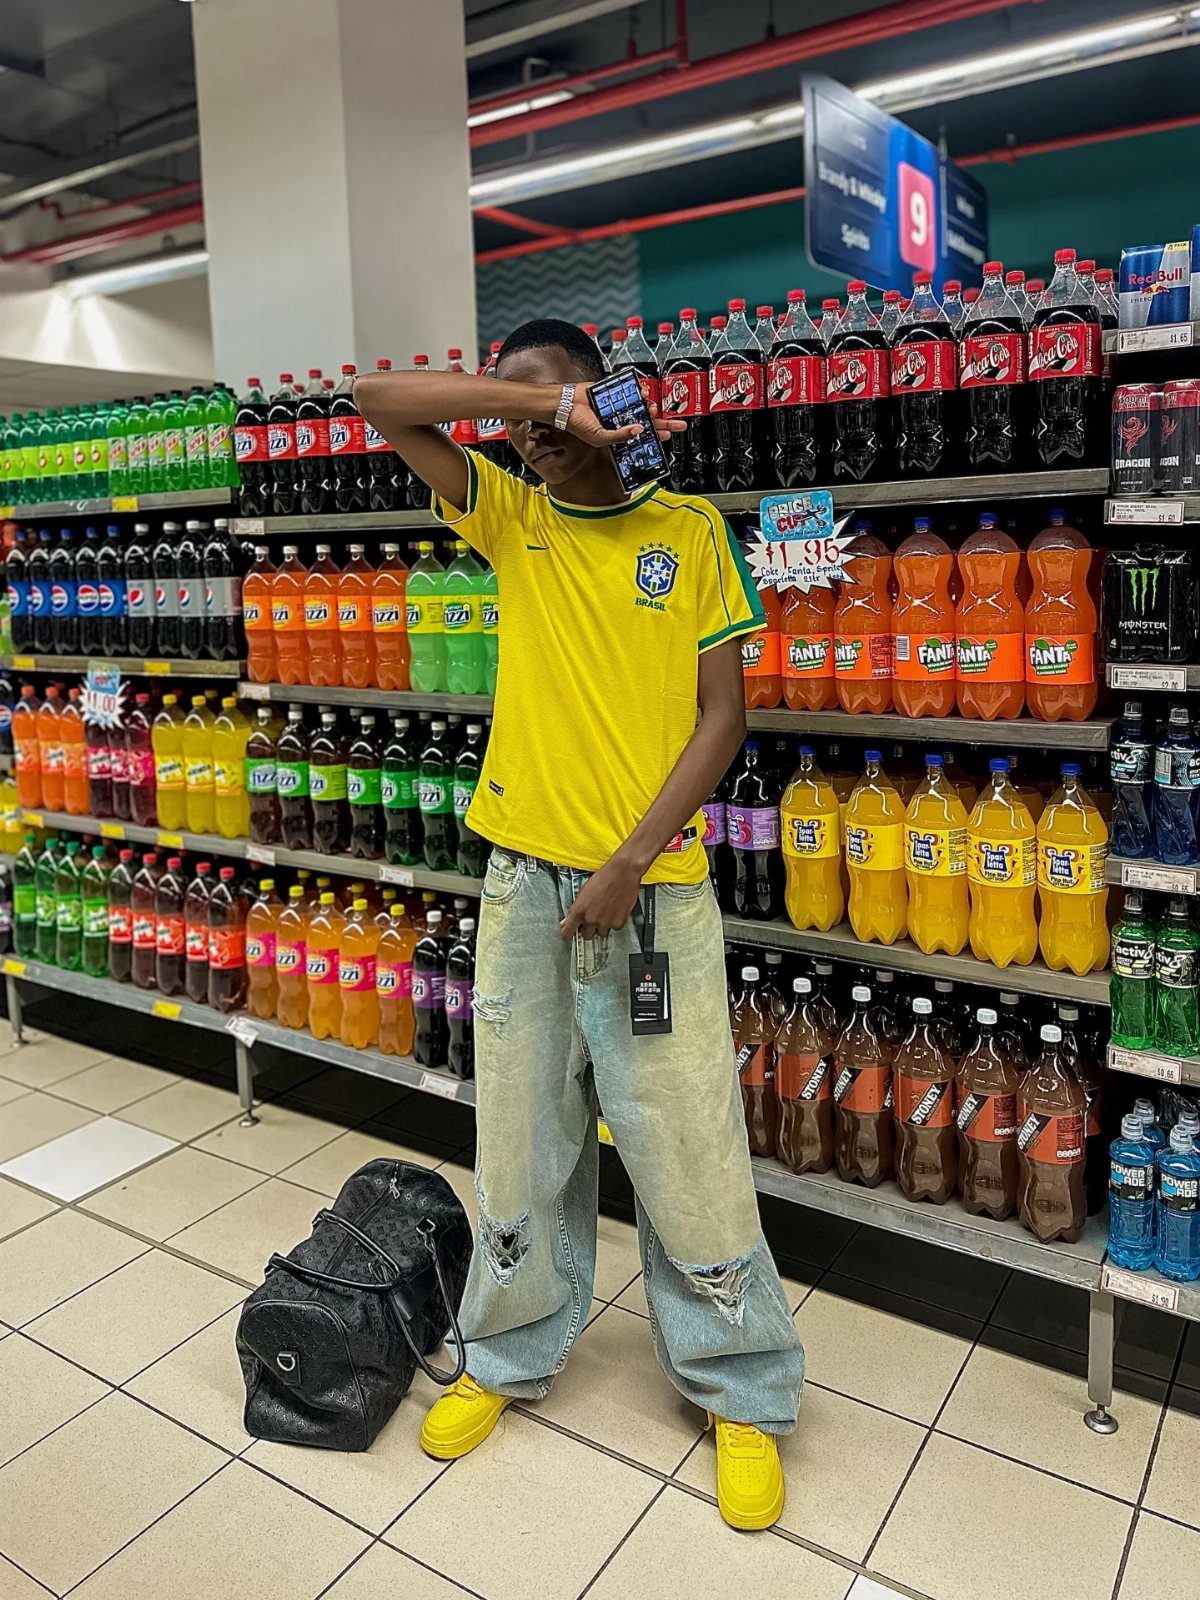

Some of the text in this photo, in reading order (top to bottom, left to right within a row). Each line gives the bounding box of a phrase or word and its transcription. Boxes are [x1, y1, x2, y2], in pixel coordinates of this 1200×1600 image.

[910, 192, 927, 246] 9
[1128, 267, 1182, 285] Red Bull
[1115, 458, 1150, 469] DRAGON
[1160, 456, 1179, 466] AGON
[768, 496, 812, 521] PRICE
[776, 513, 808, 532] CUT
[765, 538, 841, 570] $1.95
[635, 598, 667, 612] BRASIL
[1118, 620, 1167, 630] MONSTER
[742, 644, 761, 659] NTA
[789, 643, 827, 662] FANTA
[835, 644, 859, 661] ANTA
[1030, 646, 1072, 665] FANTA
[1111, 749, 1143, 763] ctiv8
[987, 851, 1004, 861] Spar-
[1052, 856, 1070, 867] Spar-
[986, 860, 1004, 870] letta
[1052, 864, 1070, 876] letta
[1116, 943, 1155, 960] activ8
[1155, 952, 1187, 968] tiv8
[736, 1045, 751, 1070] ONEY
[801, 1059, 827, 1099] STONEY
[834, 1067, 853, 1101] STONEY
[911, 1084, 941, 1124] STONEY
[957, 1094, 978, 1129] STONEY
[1017, 1114, 1041, 1149] STONEY
[1111, 1161, 1145, 1178] POWER
[1124, 1176, 1146, 1187] ADE
[1161, 1173, 1198, 1189] POWER
[1176, 1187, 1198, 1198] ADE
